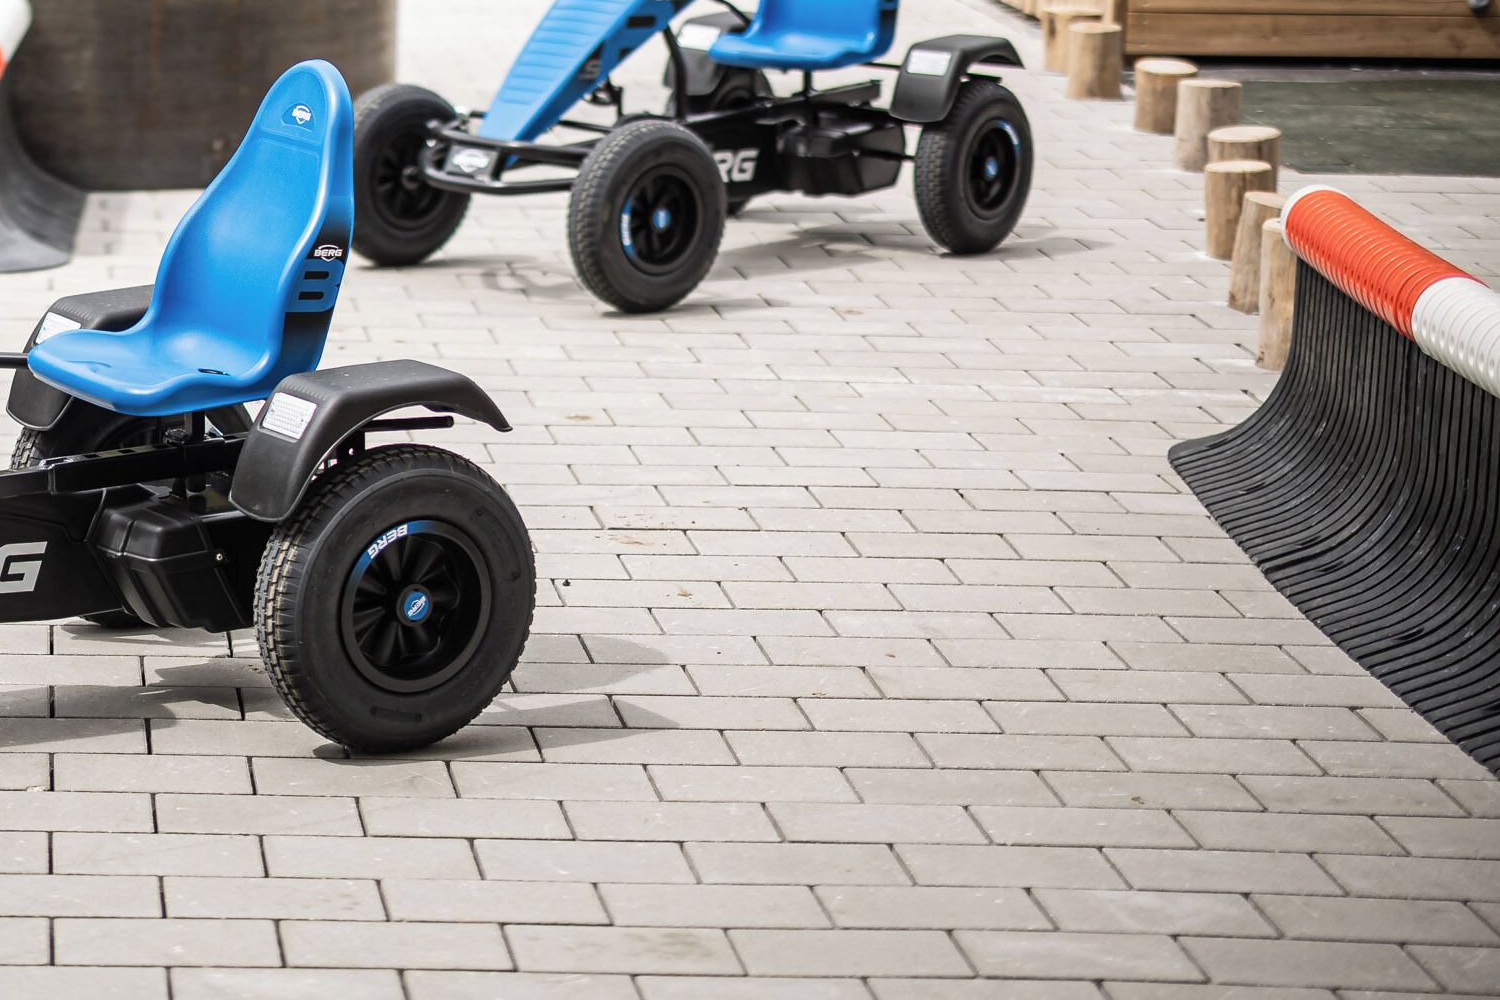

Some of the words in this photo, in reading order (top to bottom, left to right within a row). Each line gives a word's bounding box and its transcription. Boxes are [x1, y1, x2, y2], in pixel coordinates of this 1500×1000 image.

[713, 149, 759, 182] RG
[313, 248, 343, 258] BERG
[366, 523, 409, 560] BERG
